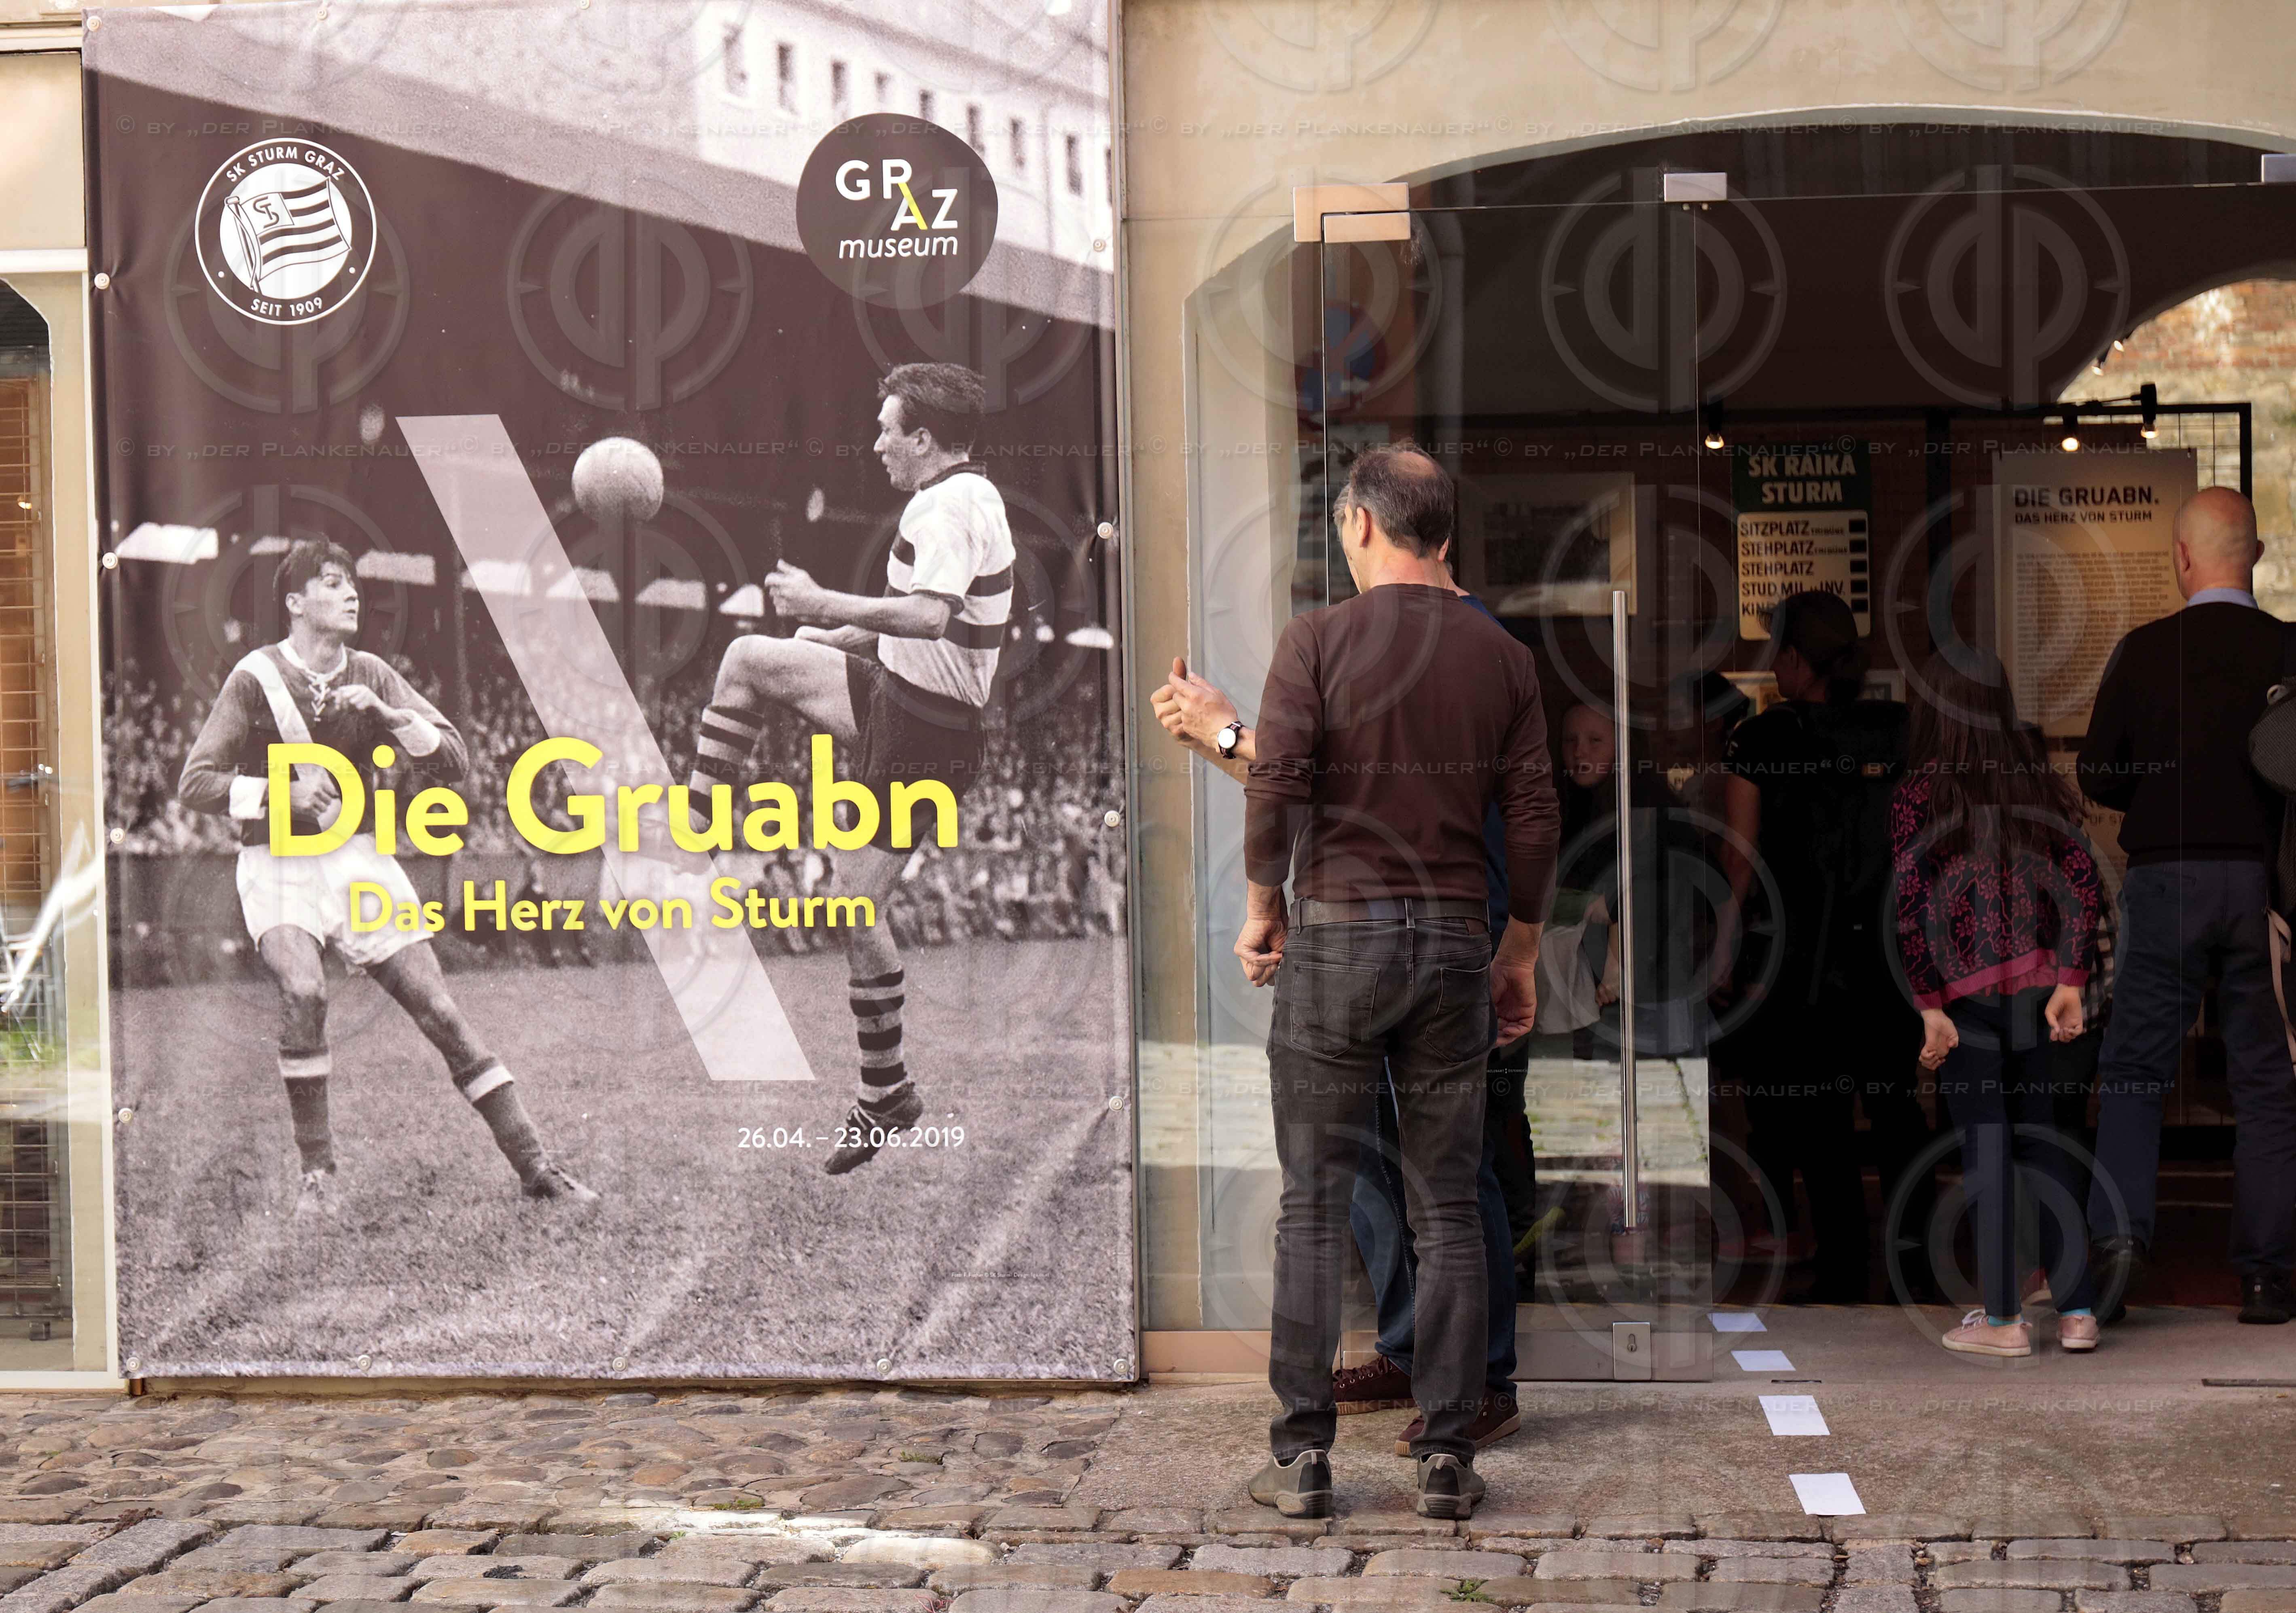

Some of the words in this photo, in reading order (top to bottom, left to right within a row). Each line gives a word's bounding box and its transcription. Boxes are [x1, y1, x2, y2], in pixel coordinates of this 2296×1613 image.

[226, 162, 246, 182] SK
[248, 146, 298, 167] STURM
[305, 150, 345, 180] GRAZ
[835, 159, 958, 231] GRAZ
[839, 236, 958, 259] museum
[250, 298, 282, 316] SEIT
[289, 296, 323, 317] 1909
[1747, 454, 1780, 478] SK
[1783, 453, 1858, 478] RAIKA
[1760, 479, 1844, 505] STURM
[2014, 487, 2051, 508] DIE
[2059, 485, 2160, 507] GRUABN.
[1740, 519, 1810, 537] SITZPLATZ
[2014, 513, 2040, 524] DAS
[2044, 512, 2076, 523] HERZ
[2080, 510, 2104, 522] VON
[2110, 510, 2152, 522] STURM
[1741, 540, 1814, 557] STEHPLATZ
[1741, 560, 1814, 576] STEHPLATZ
[267, 743, 468, 857] Die
[506, 734, 958, 855] Gruabn
[349, 881, 445, 932] Das
[463, 879, 585, 931] Herz
[599, 898, 693, 930] von
[710, 876, 875, 929] Sturm
[737, 1127, 811, 1148] 26.04.
[834, 1126, 965, 1148] 23.06.2019
